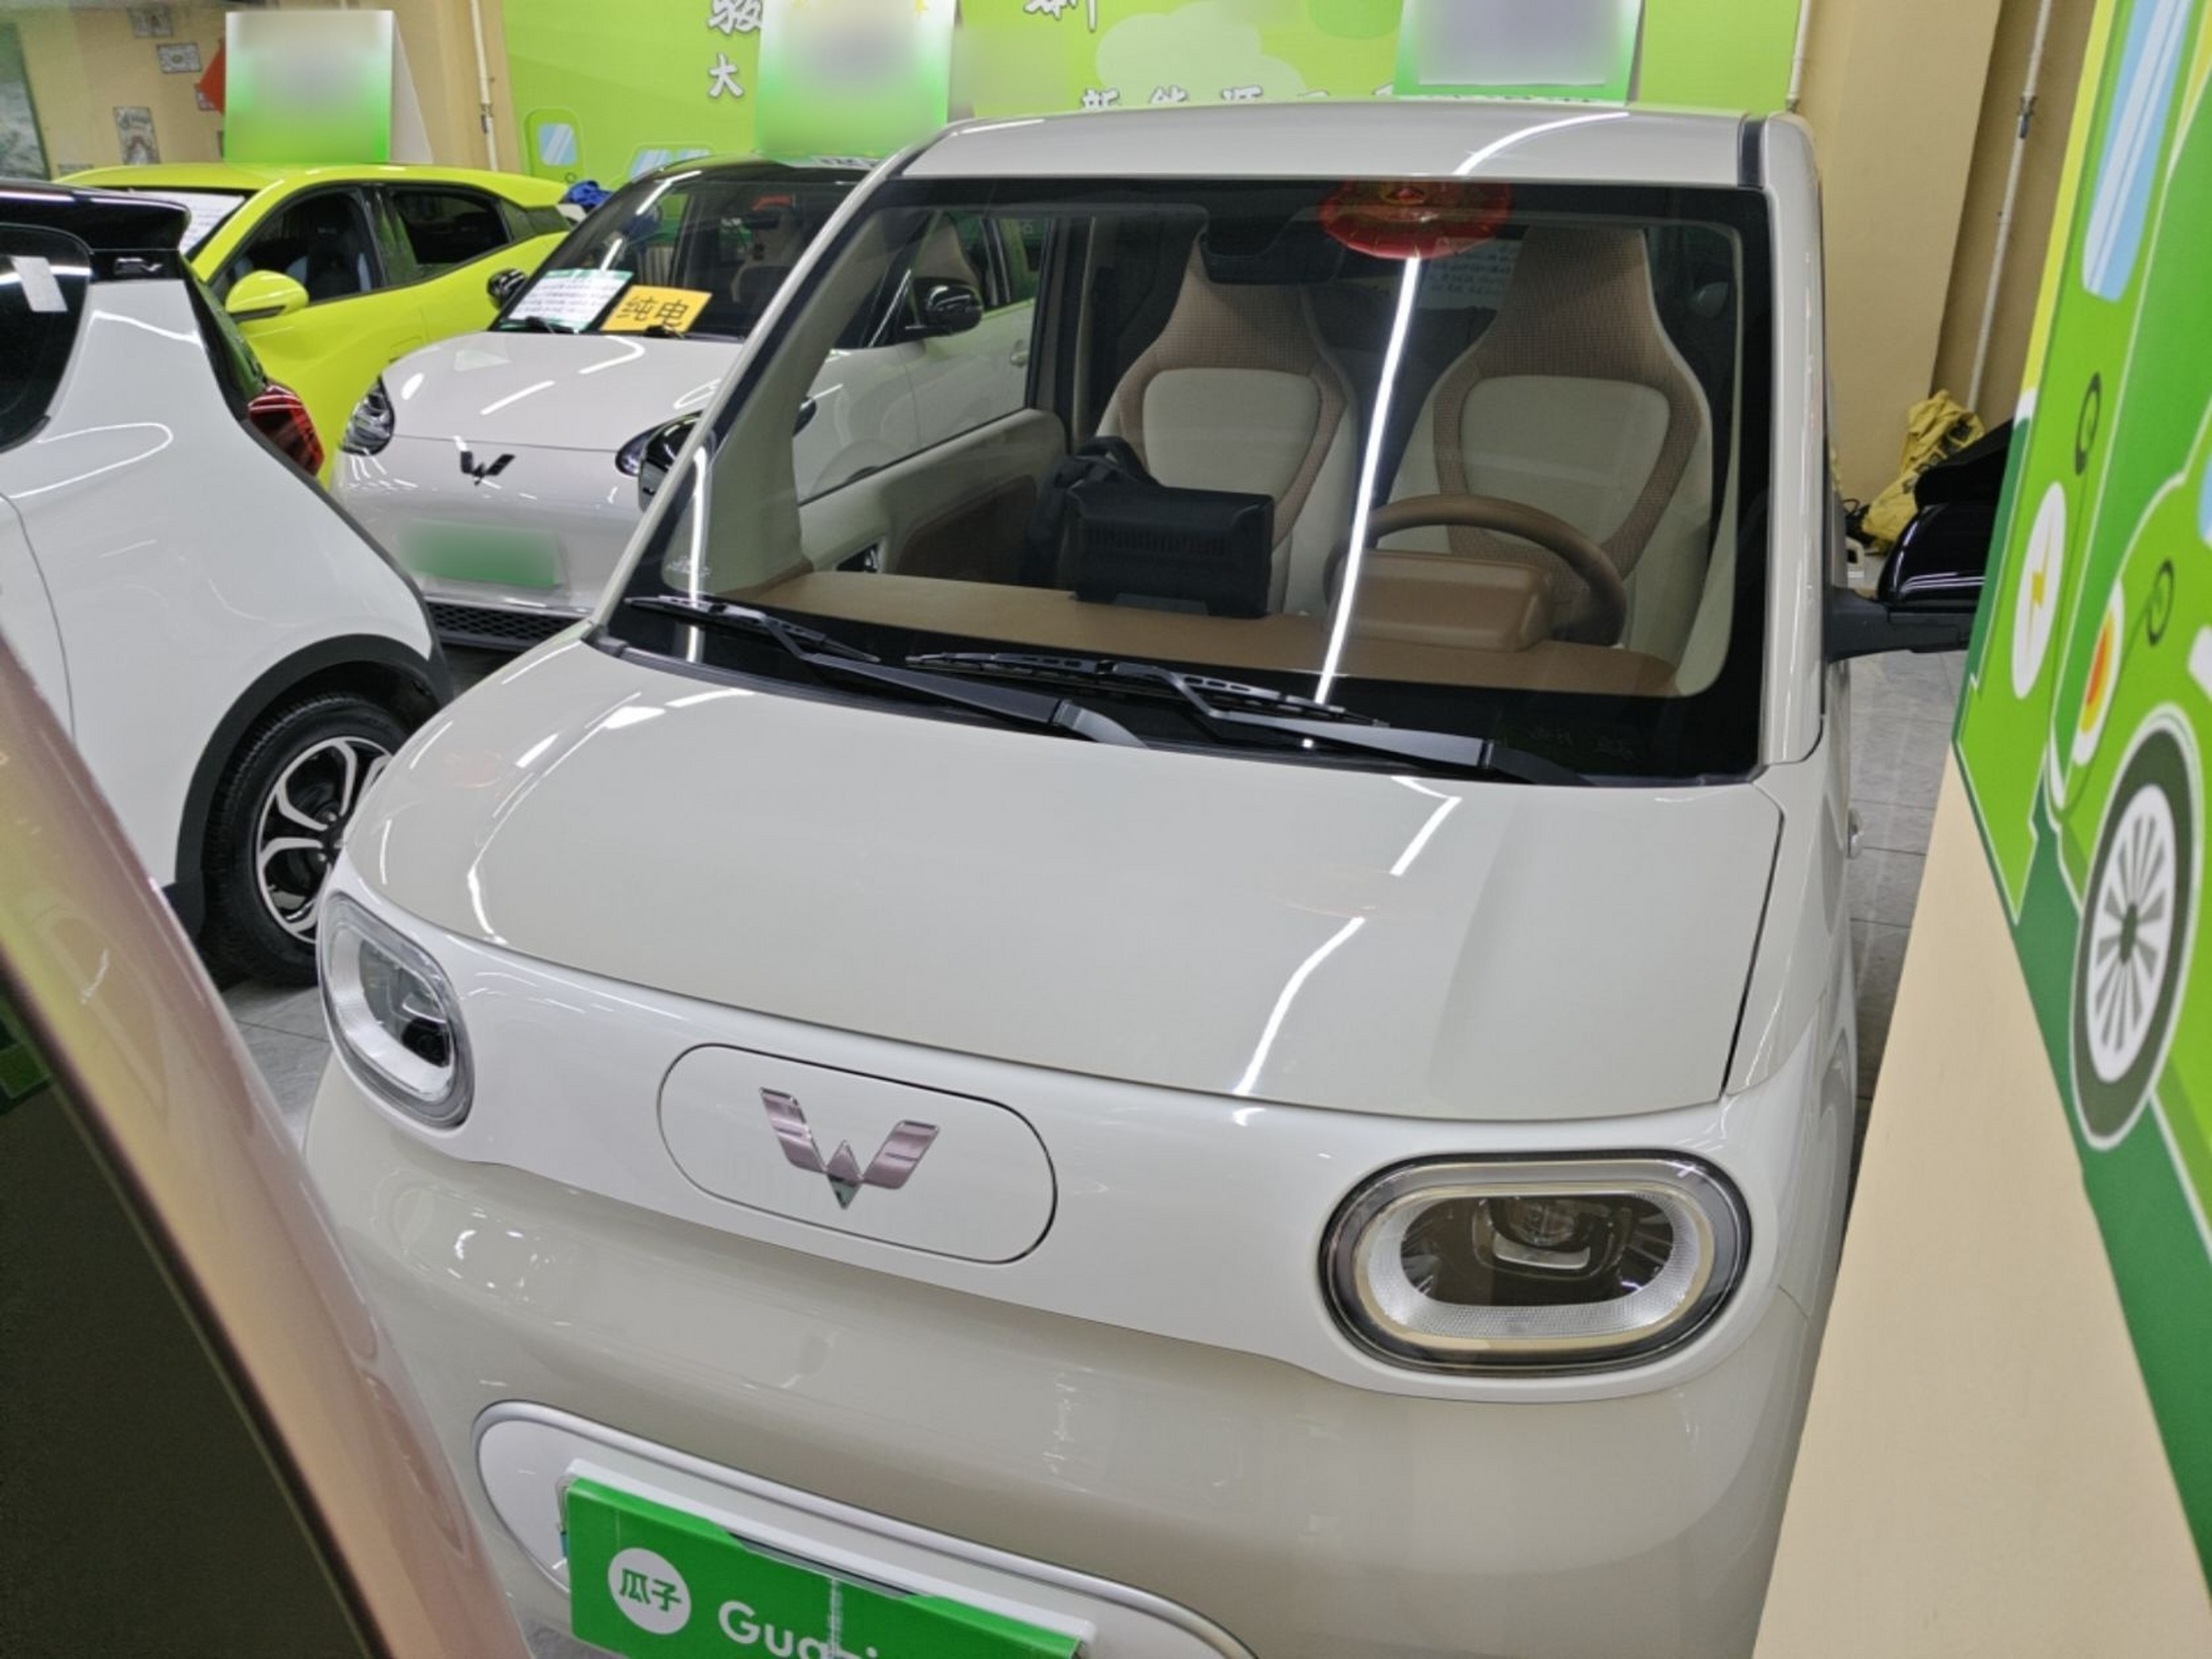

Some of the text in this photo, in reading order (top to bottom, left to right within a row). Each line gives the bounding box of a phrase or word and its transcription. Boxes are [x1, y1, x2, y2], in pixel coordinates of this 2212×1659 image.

[709, 52, 744, 98] 大
[616, 296, 689, 327] 纯电
[619, 1567, 682, 1612] 瓜子
